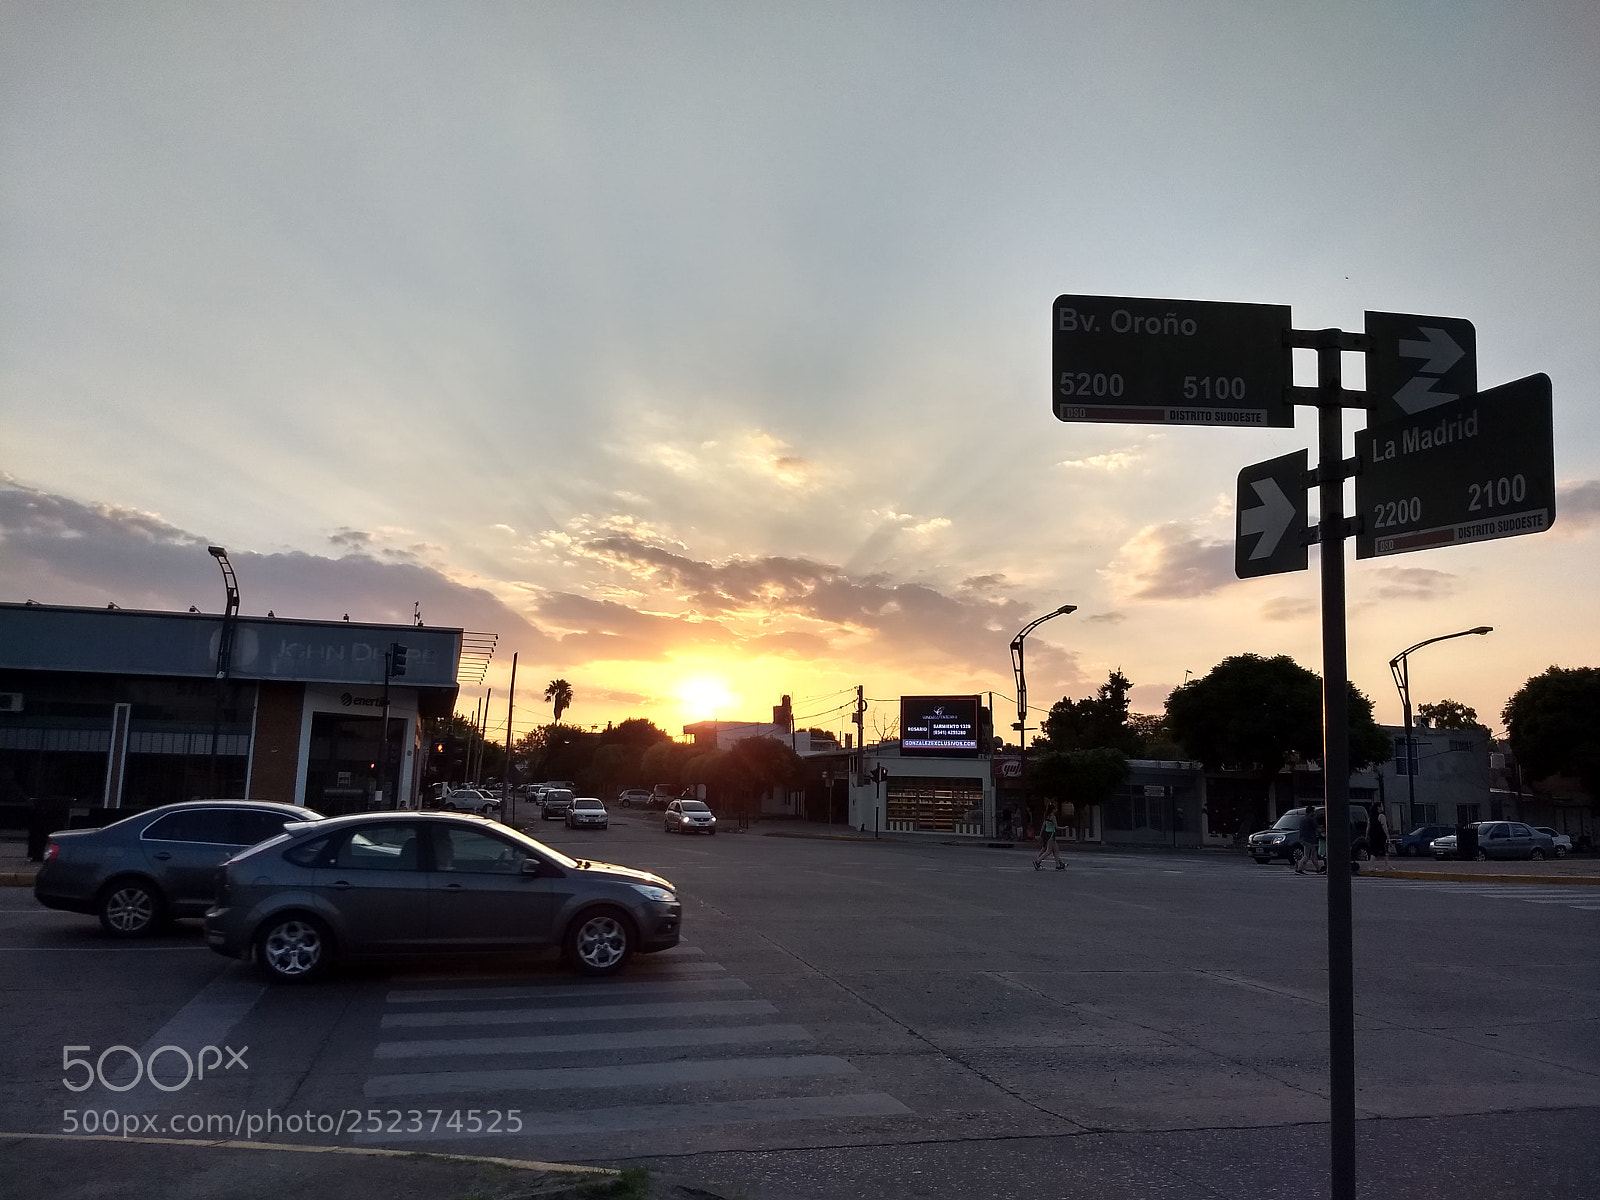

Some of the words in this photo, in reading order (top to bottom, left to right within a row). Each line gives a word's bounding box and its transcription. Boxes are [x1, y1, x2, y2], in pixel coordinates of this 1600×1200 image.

[1058, 307, 1101, 332] Bv.
[1111, 309, 1197, 336] Oroño
[1059, 371, 1124, 397] 5200
[1183, 375, 1246, 400] 5100
[1066, 407, 1086, 418] DSO
[1169, 409, 1212, 422] DISTRITO
[1214, 411, 1262, 423] SUDOESTE
[1372, 438, 1396, 463] La
[1402, 409, 1479, 456] Madrid
[1374, 496, 1421, 530] 2200
[1468, 473, 1526, 512] 2100
[1458, 522, 1495, 538] DISTRITO
[1498, 514, 1543, 533] SUDOESTE
[351, 642, 437, 665] DERE
